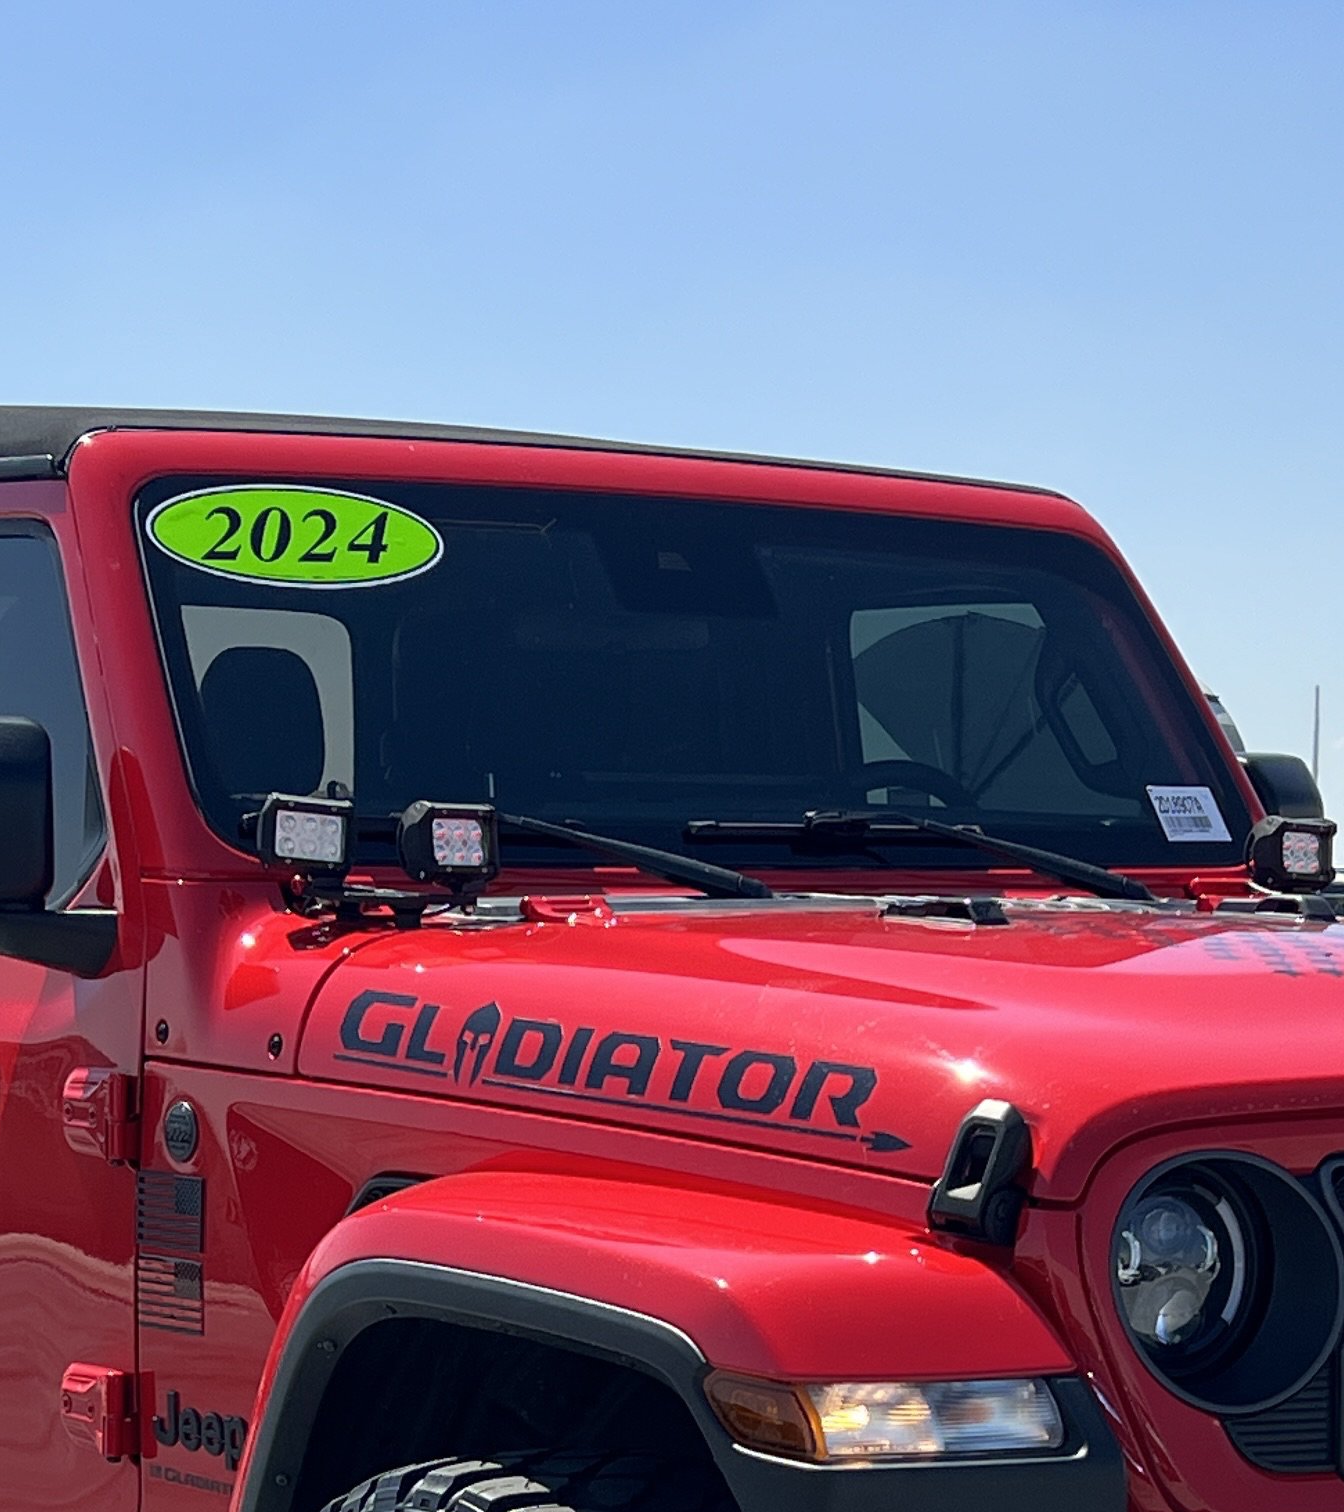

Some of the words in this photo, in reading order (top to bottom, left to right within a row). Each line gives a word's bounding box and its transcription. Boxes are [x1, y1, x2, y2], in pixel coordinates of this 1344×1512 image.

[200, 505, 390, 565] 2024
[340, 989, 878, 1128] GLADIATOR
[155, 1390, 248, 1471] Jeep
